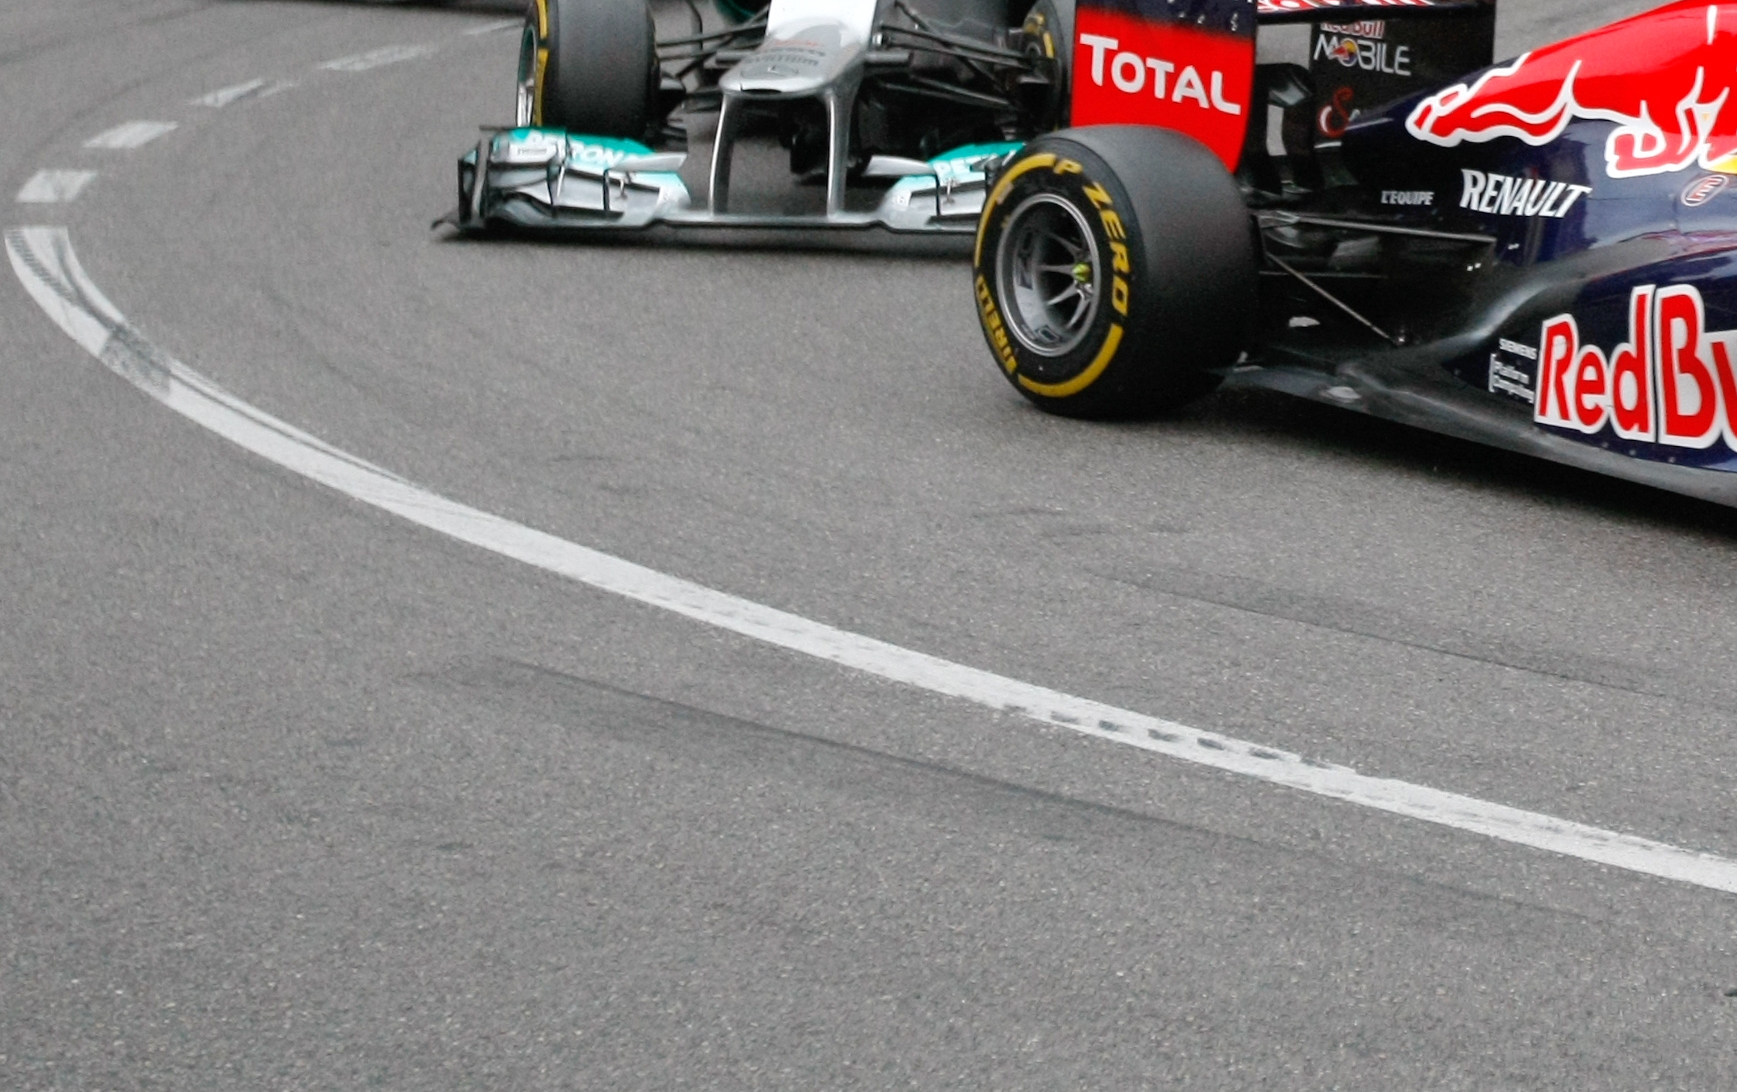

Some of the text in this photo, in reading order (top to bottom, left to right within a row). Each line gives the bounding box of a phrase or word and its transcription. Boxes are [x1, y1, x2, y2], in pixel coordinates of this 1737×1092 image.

[1080, 34, 1241, 115] TOTAL
[1314, 34, 1412, 77] MOBILE
[1460, 169, 1593, 219] RENAULT
[1053, 158, 1131, 317] P ZERO
[1499, 337, 1538, 361] SIEMENS
[1534, 284, 1656, 443] Red
